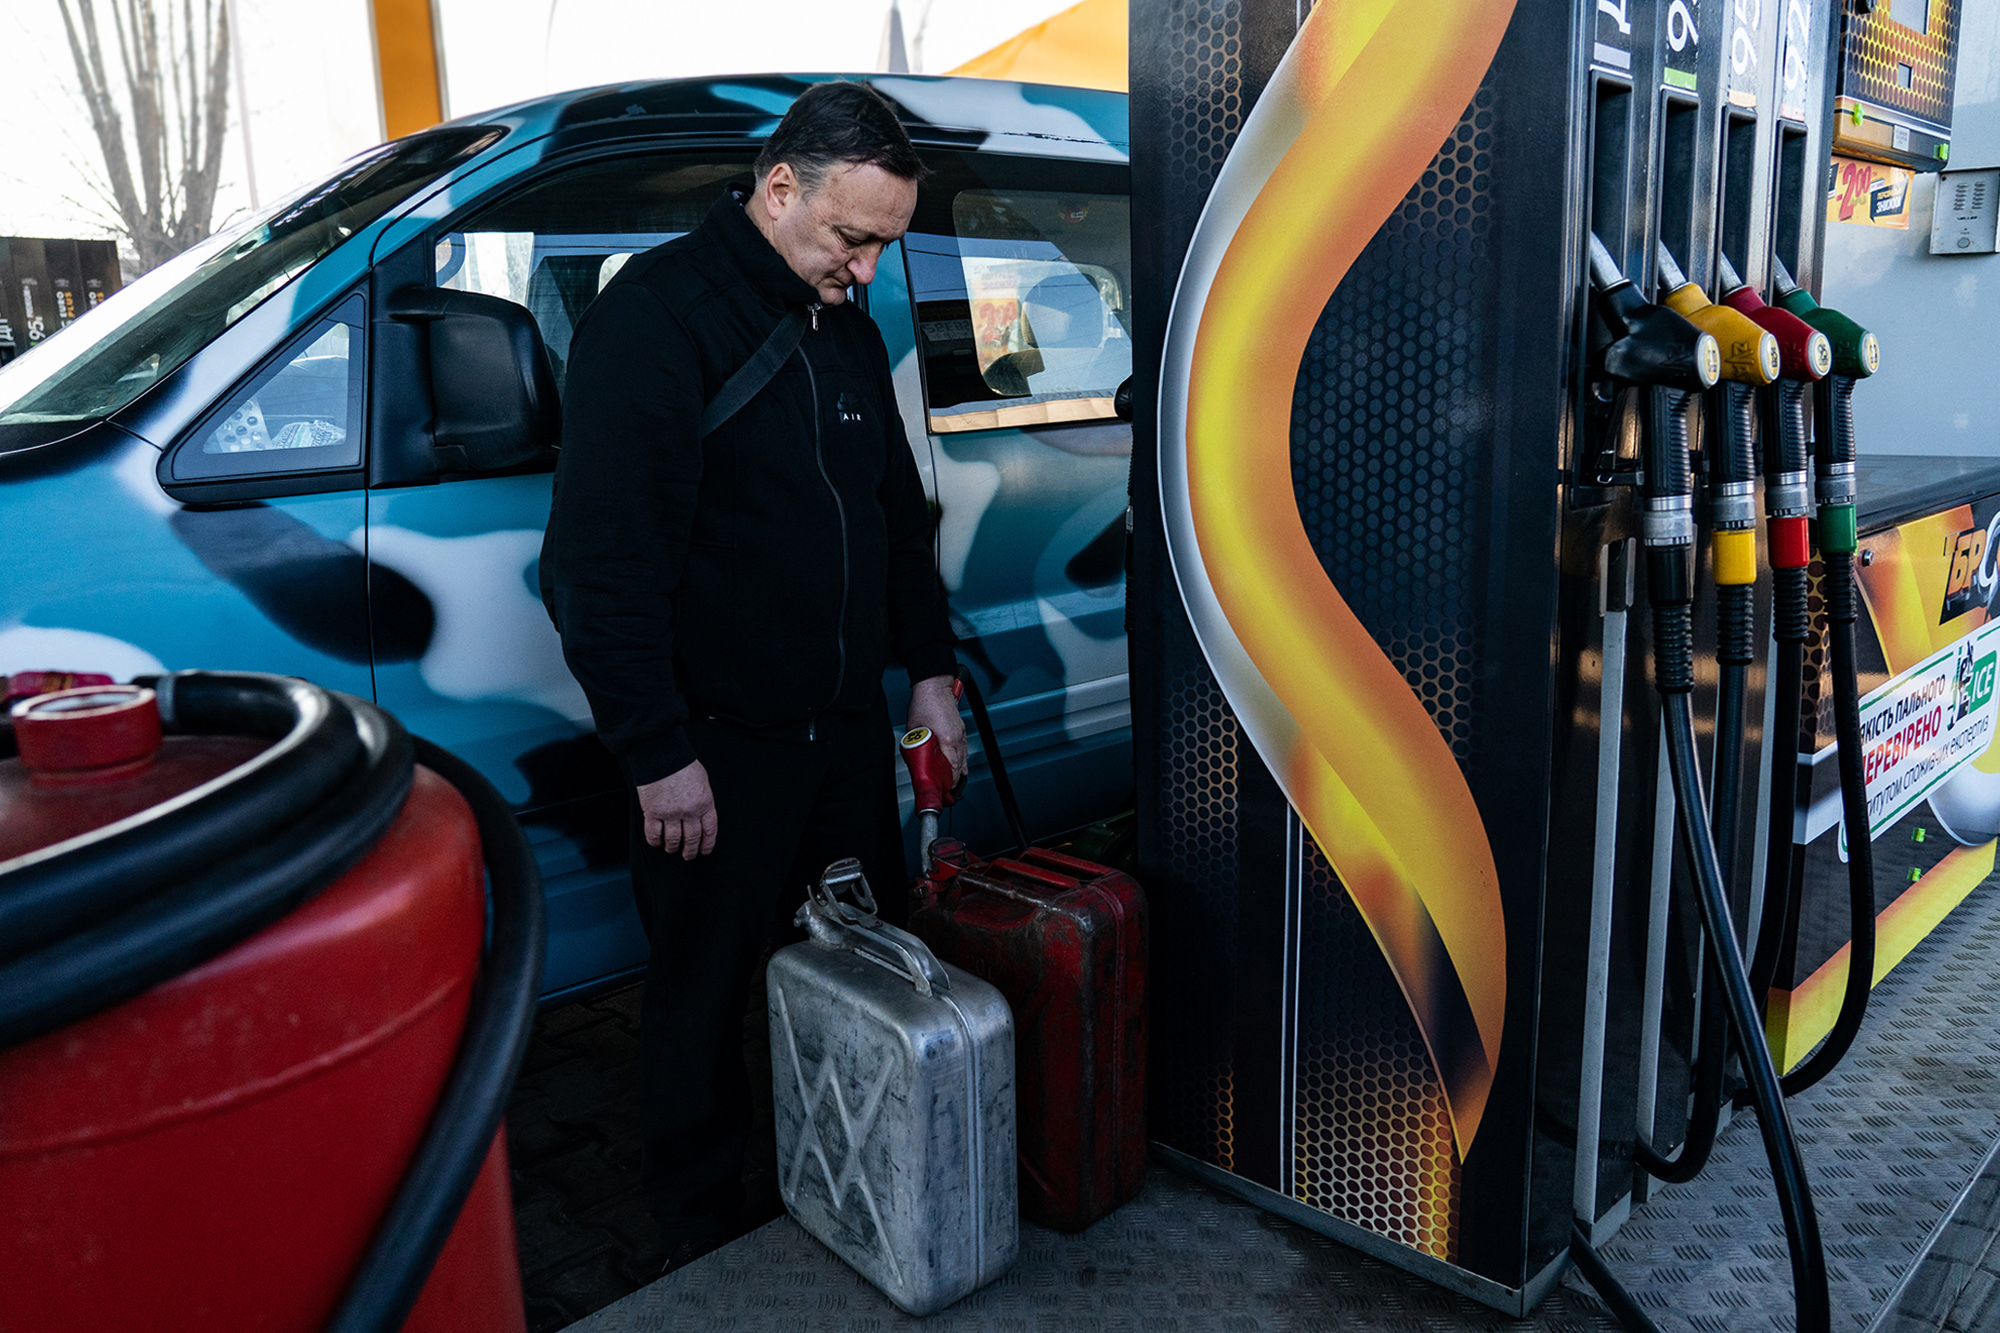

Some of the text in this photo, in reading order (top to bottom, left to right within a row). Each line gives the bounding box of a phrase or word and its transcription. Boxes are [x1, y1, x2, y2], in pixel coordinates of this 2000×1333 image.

[1784, 0, 1811, 90] 92
[843, 413, 861, 421] AIR
[1895, 674, 1945, 724] ПАЛЬНОГО
[1949, 714, 1989, 757] експертиз
